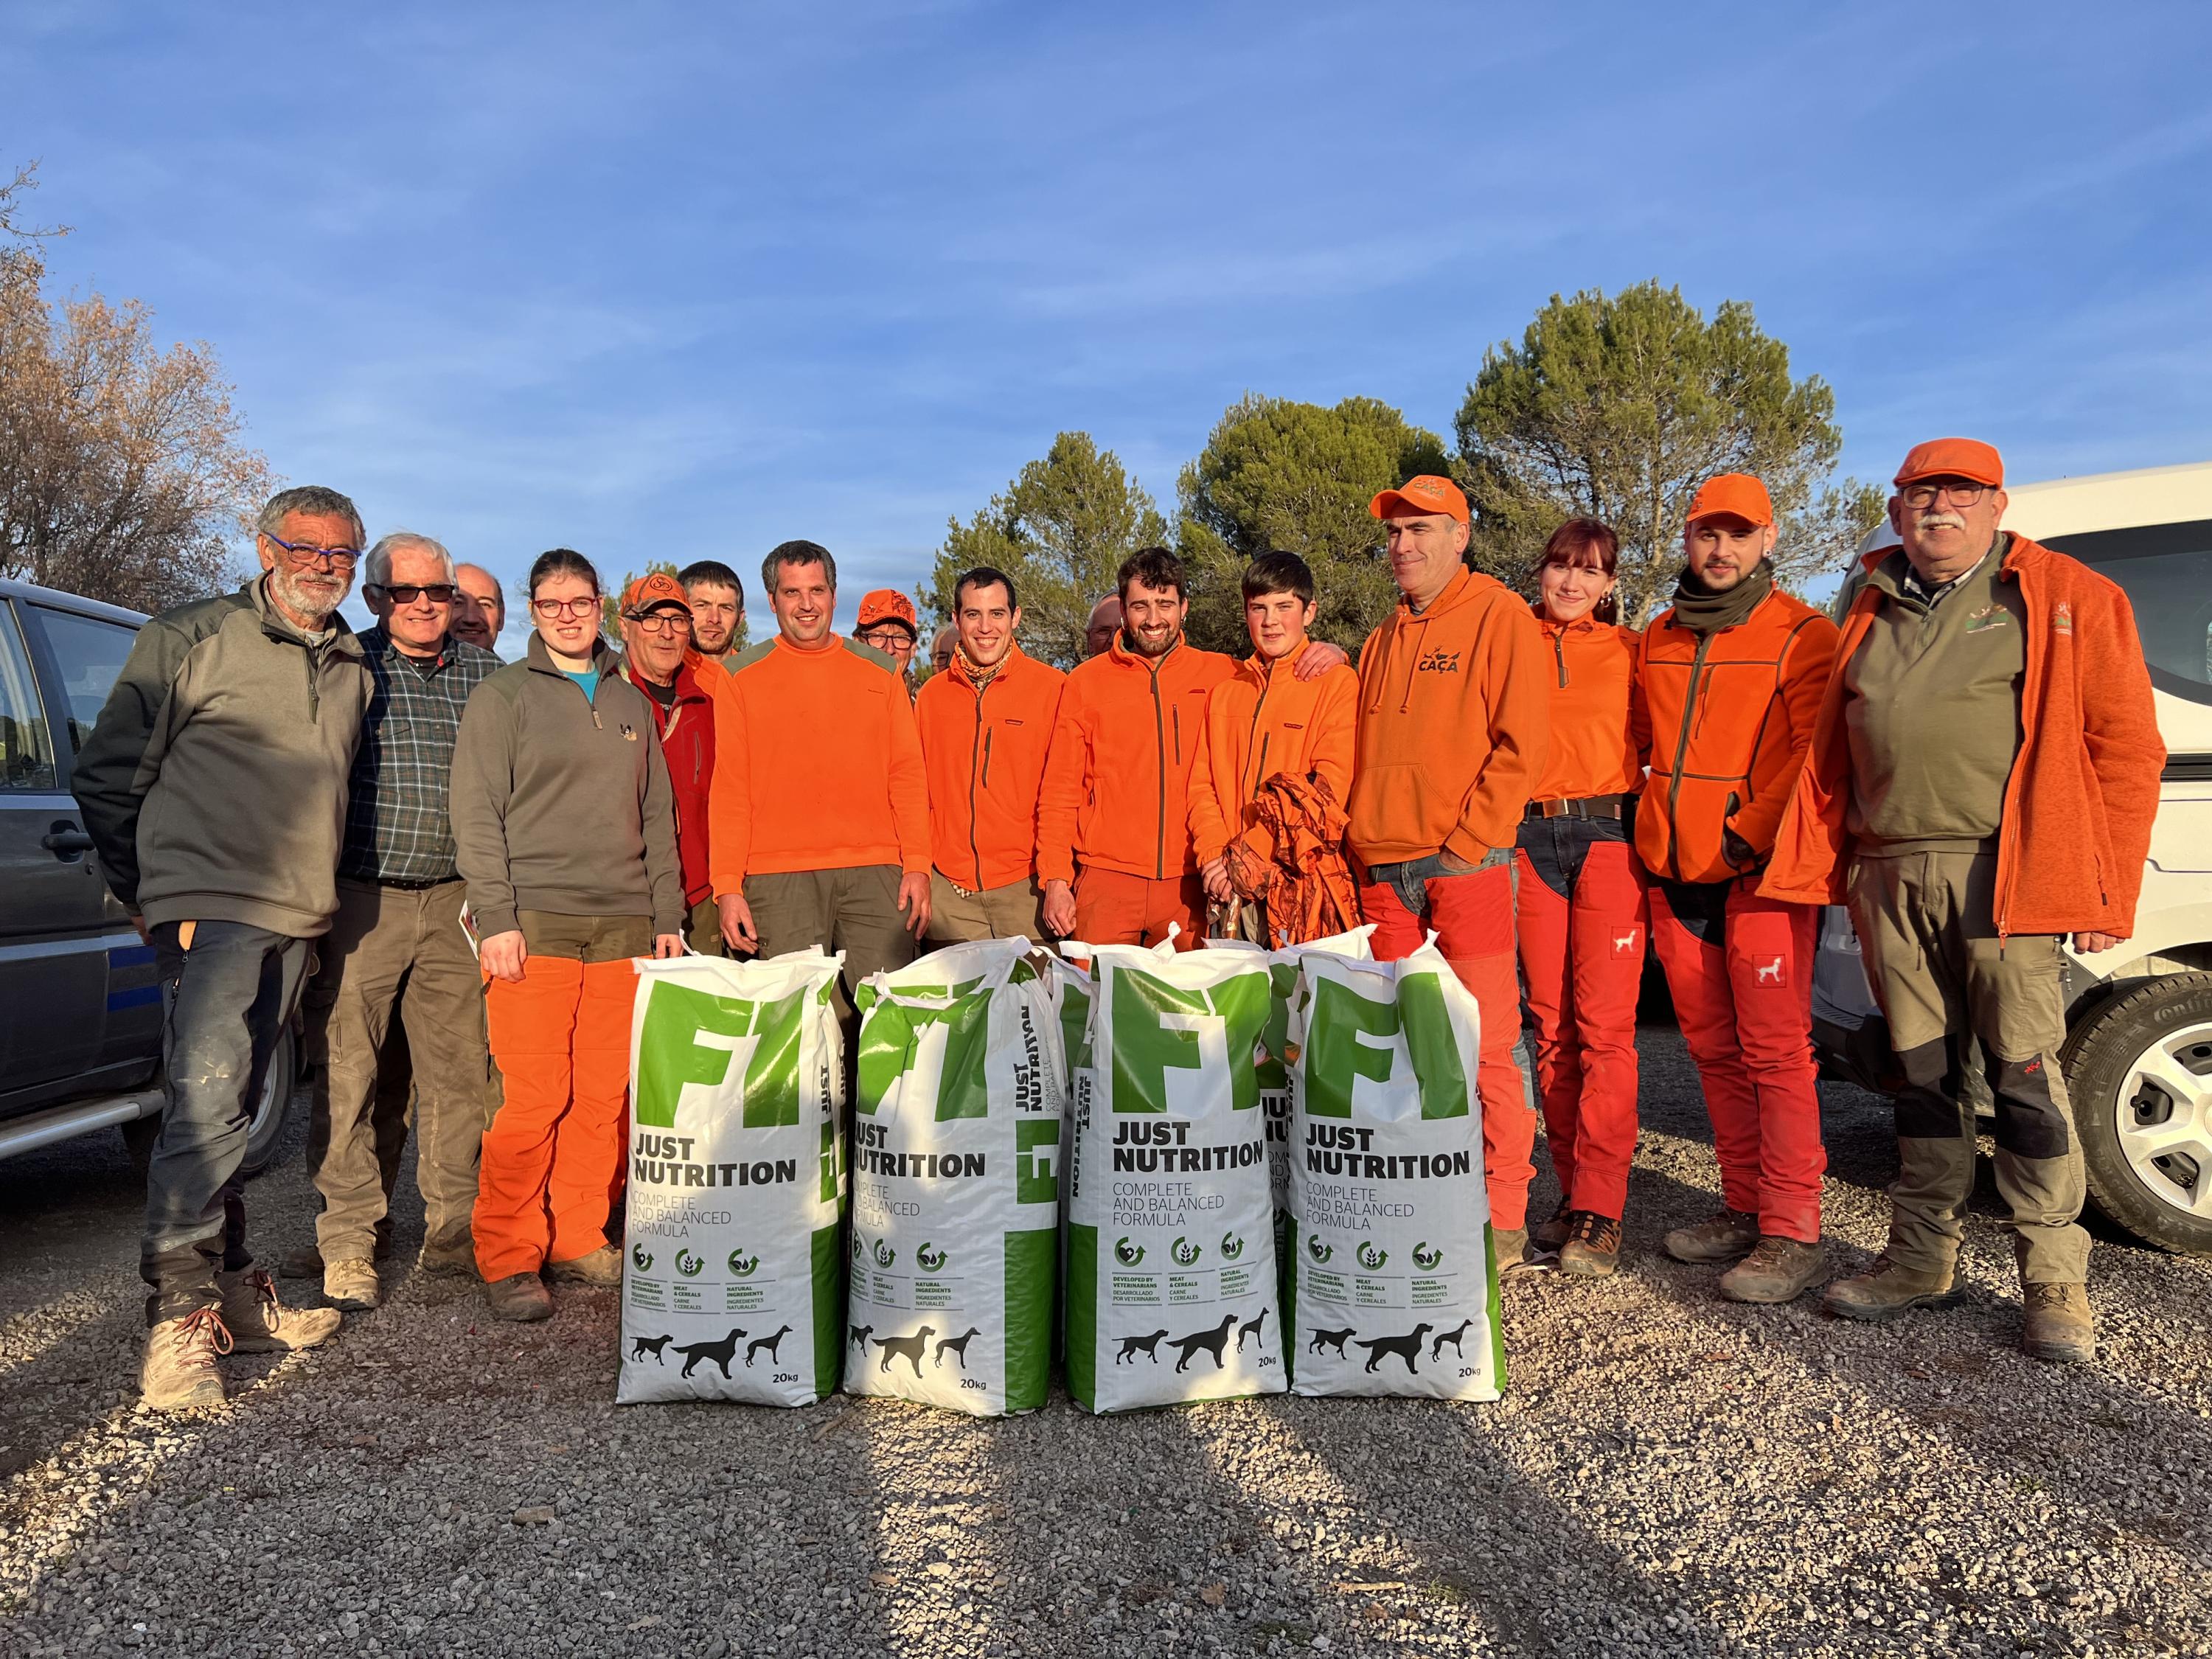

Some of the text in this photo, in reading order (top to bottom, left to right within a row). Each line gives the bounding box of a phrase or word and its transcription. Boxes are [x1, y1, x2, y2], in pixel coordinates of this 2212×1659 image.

[1419, 660, 1458, 674] CAÇA
[1112, 966, 1272, 1113] F1
[1305, 972, 1469, 1120] F1
[636, 979, 809, 1128] F1
[1021, 1006, 1042, 1111] NUTRITION
[1014, 1063, 1029, 1112] JUST
[1082, 1076, 1091, 1130] JUST
[1073, 1076, 1085, 1197] NUTRITION
[1113, 1121, 1190, 1145] JUST
[1306, 1124, 1374, 1151] JUST
[636, 1133, 695, 1160] JUST
[1113, 1139, 1263, 1172] NUTRITION
[635, 1158, 796, 1187] NUTRITION
[1307, 1149, 1470, 1179] NUTRITION
[1113, 1183, 1192, 1196] COMPLETE
[1306, 1181, 1377, 1201] COMPLETE
[633, 1191, 696, 1209] COMPLETE
[863, 1196, 920, 1216] BALANCED
[1113, 1195, 1224, 1211] AND BALANCED
[1307, 1196, 1414, 1217] AND BALANCED
[632, 1207, 731, 1225] AND BALANCED
[1113, 1212, 1186, 1226] FORMULA
[1306, 1209, 1371, 1230] FORMULA
[632, 1219, 689, 1238] FORMULA
[1308, 1270, 1333, 1280] DEVELOPED
[1308, 1276, 1344, 1287] VETERINARIANS
[1259, 1357, 1276, 1367] 20kg
[1459, 1367, 1481, 1377] 20kg
[773, 1374, 799, 1382] 20kg
[961, 1379, 987, 1390] 20kg
